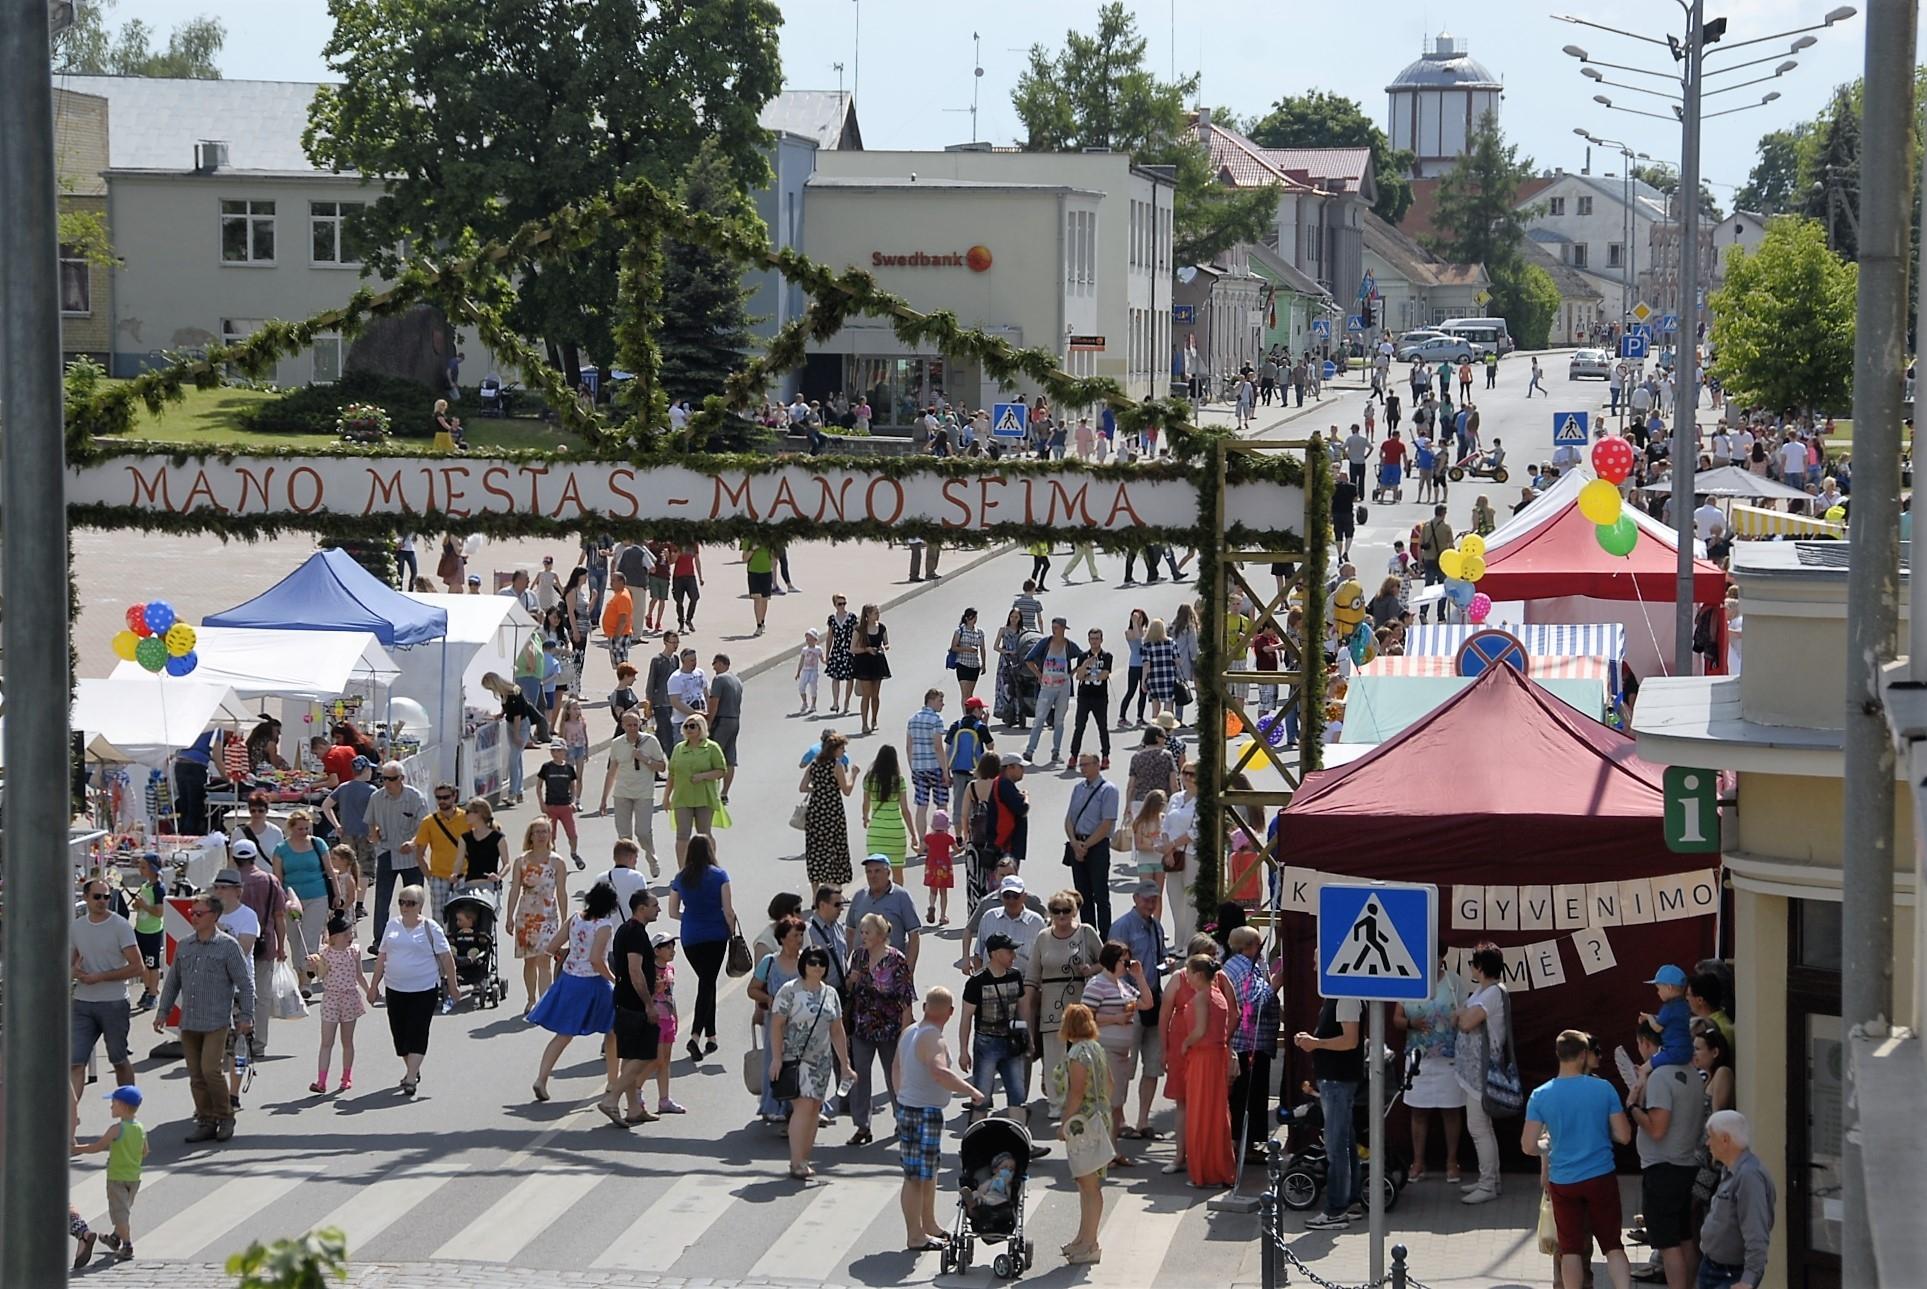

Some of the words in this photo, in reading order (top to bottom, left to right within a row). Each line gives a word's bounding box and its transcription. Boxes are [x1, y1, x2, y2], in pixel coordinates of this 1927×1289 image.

[872, 251, 963, 267] Swedbank
[1628, 338, 1642, 356] P
[124, 466, 325, 514] MANO
[361, 466, 640, 520] MIESTAS
[709, 473, 904, 525] MANO
[940, 476, 1147, 529] SEIMA
[1460, 884, 1714, 921] GYVENIMO
